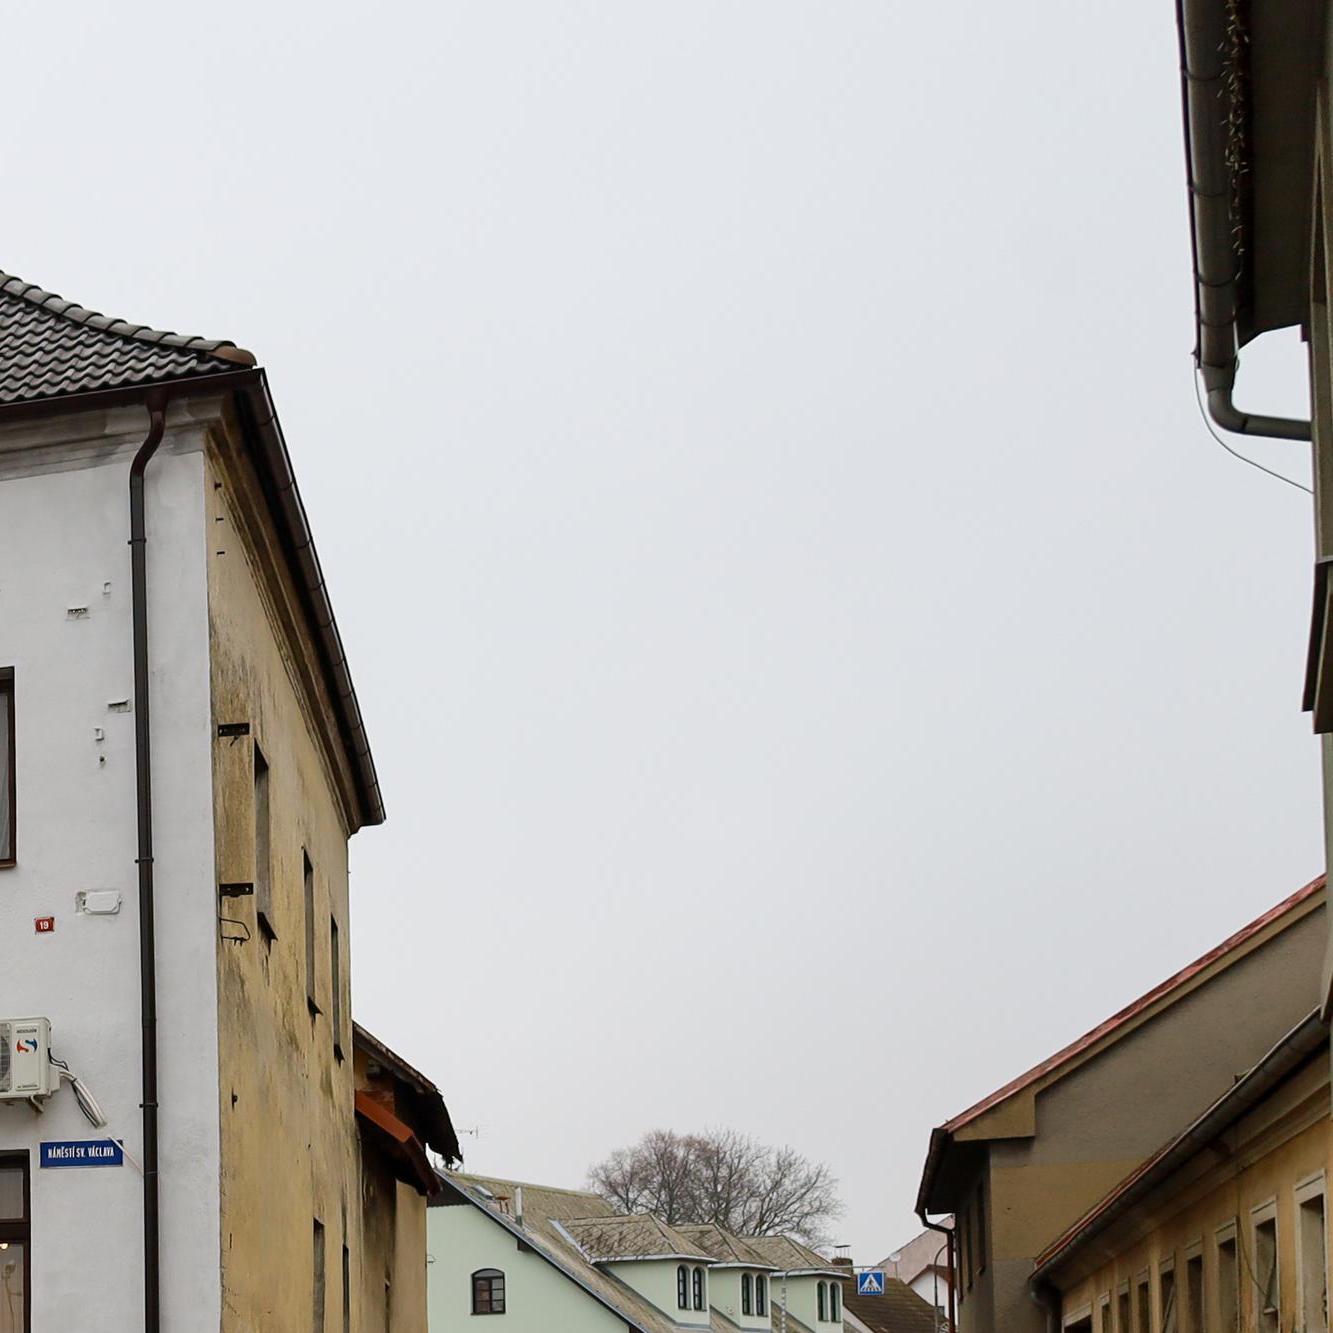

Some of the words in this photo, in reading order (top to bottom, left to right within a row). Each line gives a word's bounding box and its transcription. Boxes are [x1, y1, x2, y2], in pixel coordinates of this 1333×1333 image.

[39, 921, 49, 930] 19
[48, 1146, 75, 1158] NÁMĚSTÍ
[88, 1145, 114, 1157] VÁCLAVA
